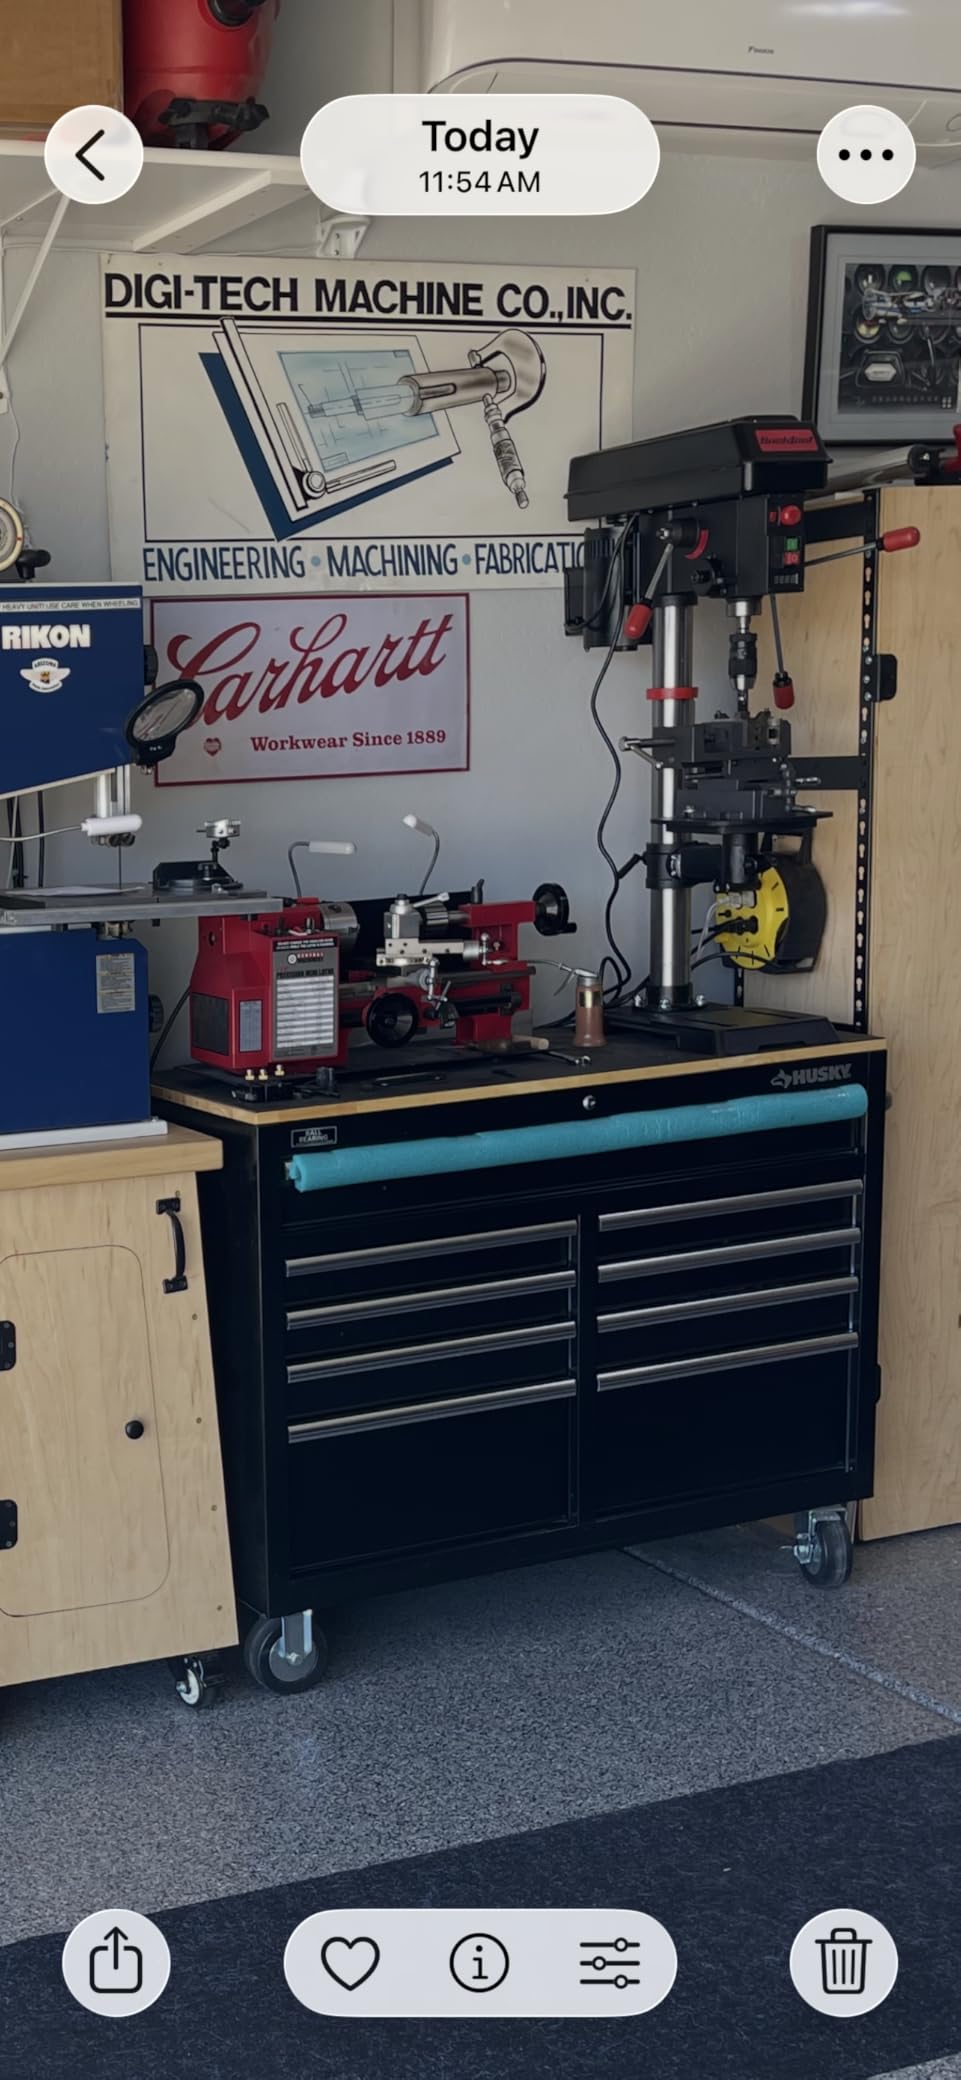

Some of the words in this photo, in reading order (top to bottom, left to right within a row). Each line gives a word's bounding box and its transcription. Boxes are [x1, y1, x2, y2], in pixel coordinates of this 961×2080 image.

[105, 272, 298, 311] DIGI-TECH
[315, 278, 483, 316] MACHINE
[142, 545, 305, 581] ENGINEERING
[326, 543, 458, 577] MACHINING
[2, 624, 91, 650] RIKON
[167, 613, 453, 730] Carhartt
[251, 735, 348, 752] Workwear
[352, 732, 402, 747] Since
[406, 730, 446, 744] 1889
[792, 1063, 852, 1085] HUSKY
